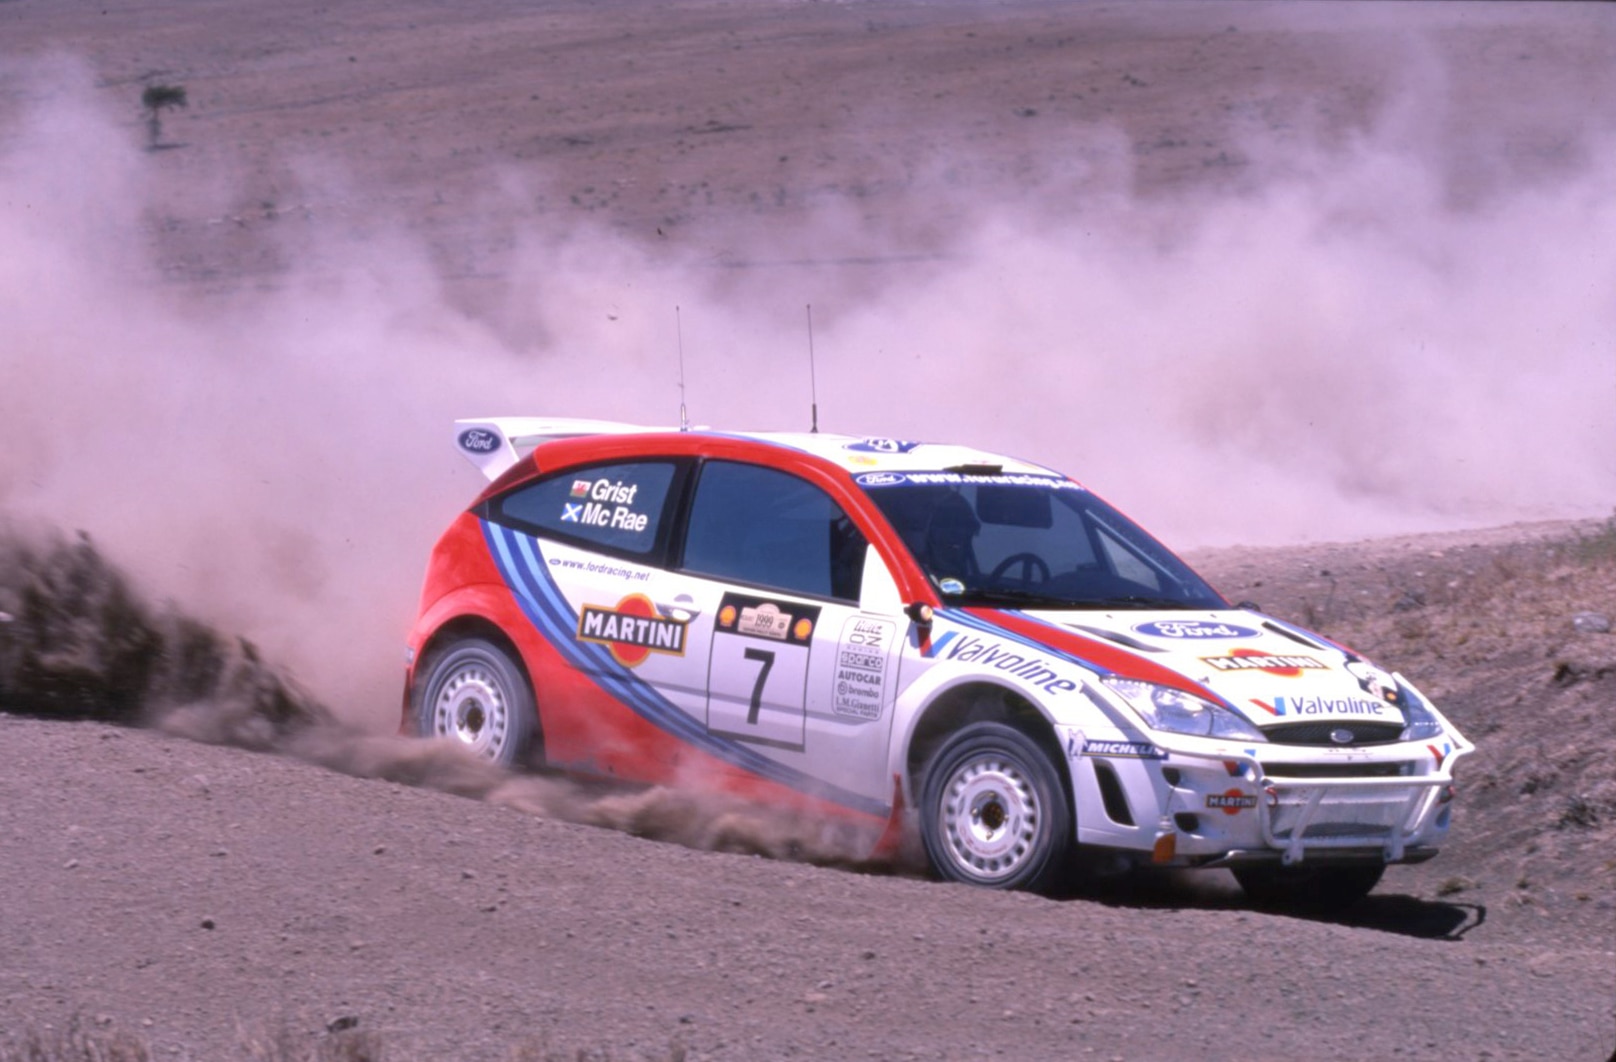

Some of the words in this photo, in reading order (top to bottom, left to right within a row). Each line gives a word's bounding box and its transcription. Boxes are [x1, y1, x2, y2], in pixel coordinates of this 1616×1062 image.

[465, 431, 494, 450] Ford
[591, 479, 637, 504] Grist
[581, 503, 610, 526] Mc
[611, 506, 647, 532] Rae
[562, 560, 650, 581] www.fordracing.net
[584, 611, 682, 649] MARTINI
[755, 613, 774, 628] 1999
[1154, 622, 1238, 637] Ford
[947, 635, 1076, 695] Valvoline
[1206, 656, 1324, 669] MARTINI
[744, 647, 775, 725] 7
[838, 670, 881, 685] AUTOCAR
[848, 684, 879, 698] brembo
[1291, 696, 1383, 715] Valvoline
[1087, 742, 1165, 756] MICHELIN
[1208, 796, 1255, 807] MARTINI
